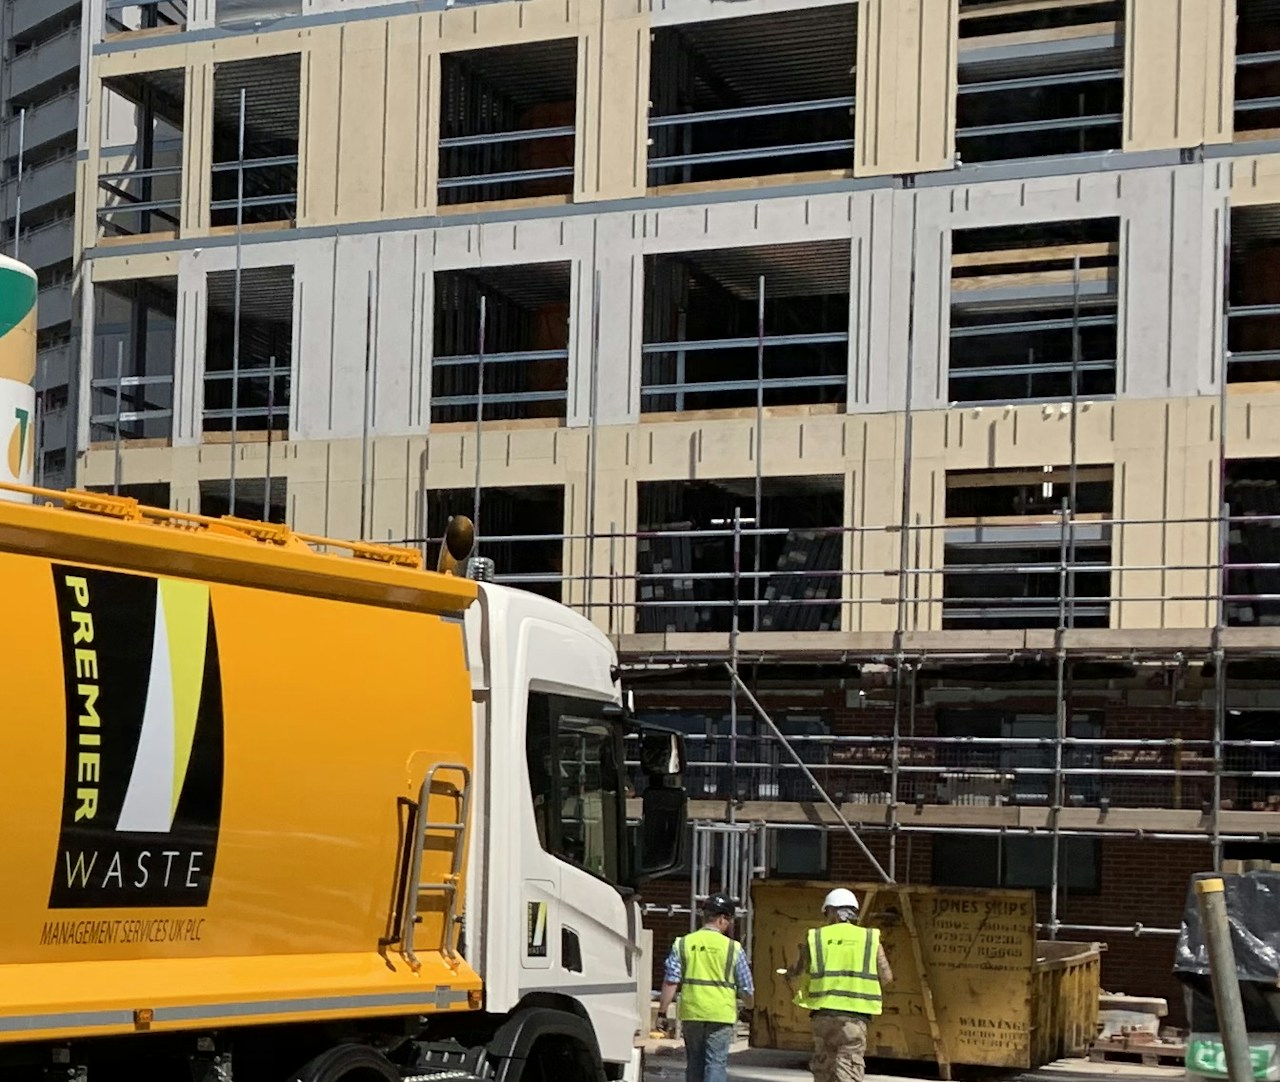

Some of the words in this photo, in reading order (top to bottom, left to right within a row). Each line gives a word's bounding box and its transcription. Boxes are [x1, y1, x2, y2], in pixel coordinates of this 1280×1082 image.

[65, 574, 101, 823] PREMIER
[65, 850, 204, 889] WASTE
[931, 898, 979, 915] JONES
[40, 920, 122, 946] MANAGEMENT
[120, 919, 170, 944] SERVICES
[169, 919, 188, 942] UK
[183, 918, 207, 942] PLC
